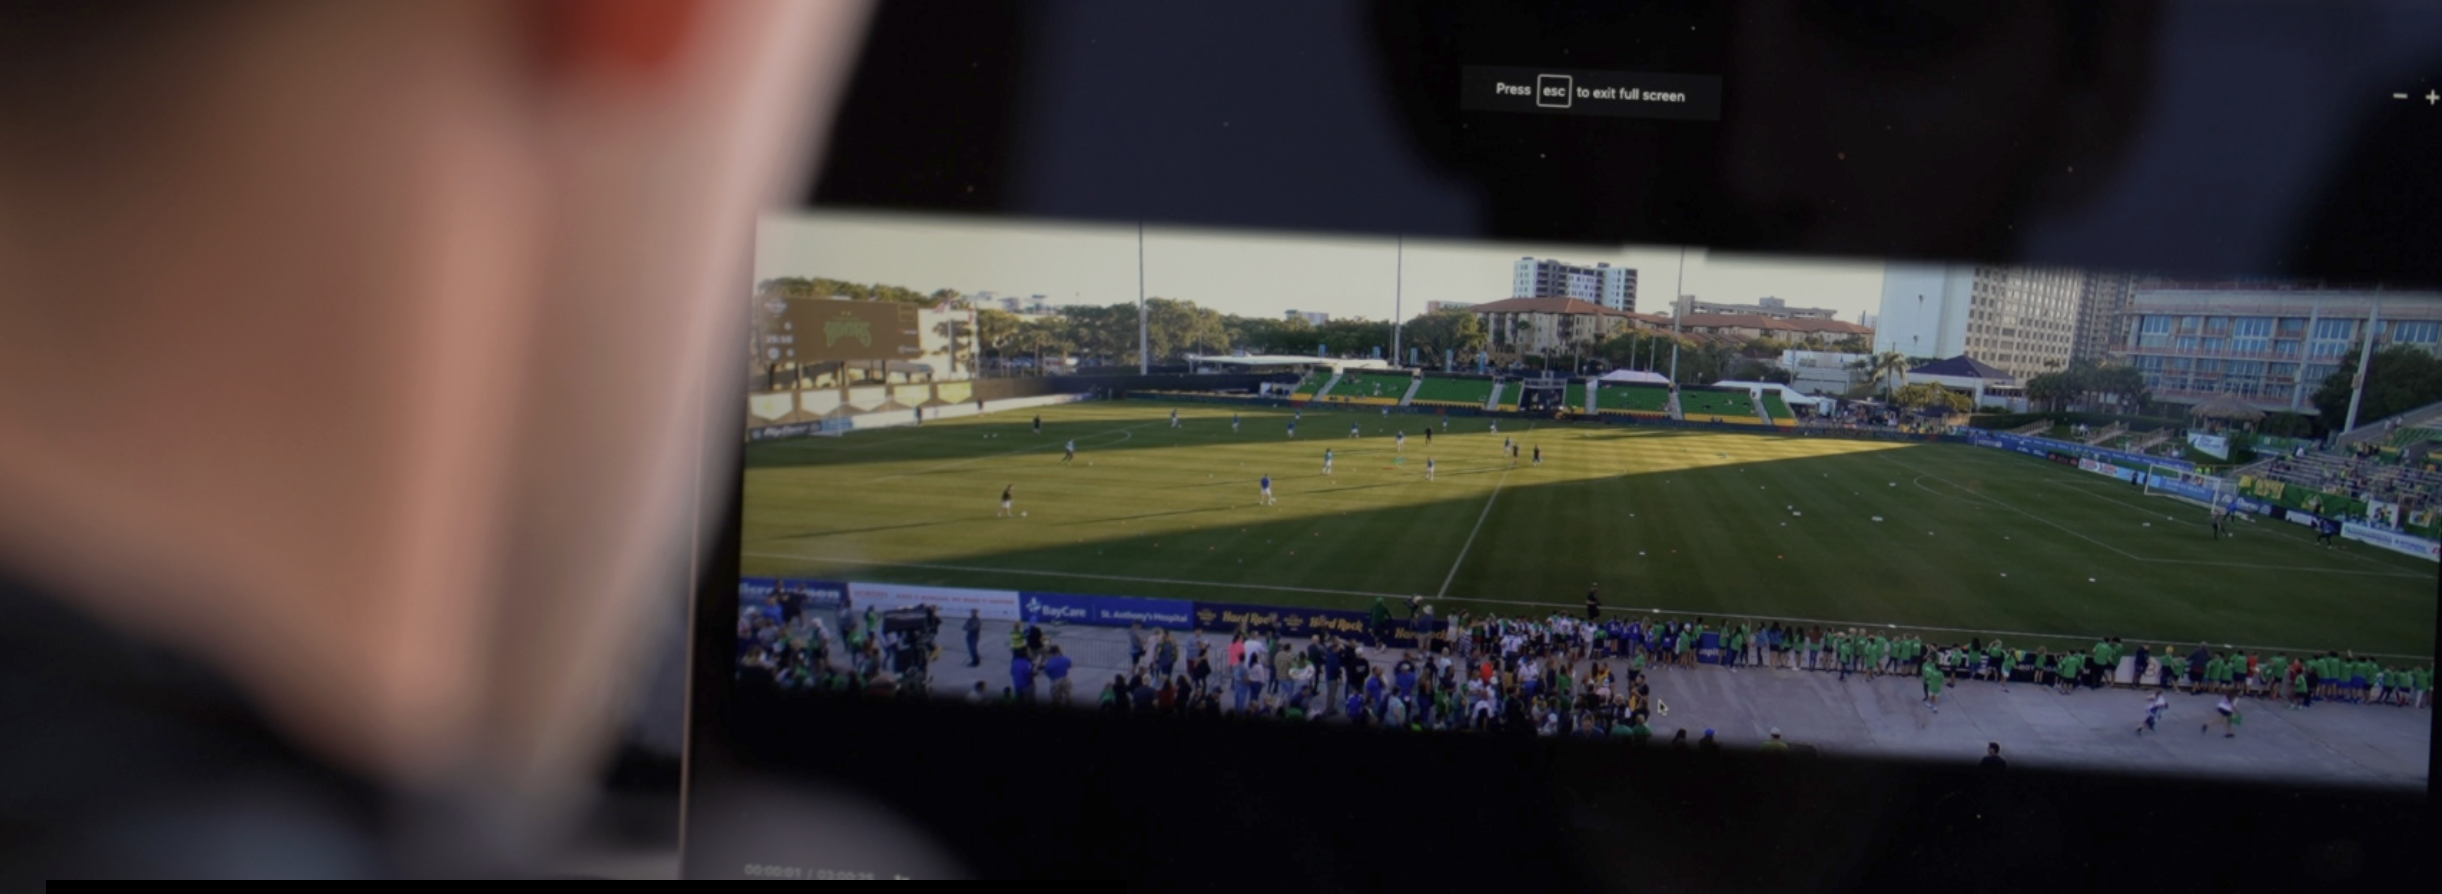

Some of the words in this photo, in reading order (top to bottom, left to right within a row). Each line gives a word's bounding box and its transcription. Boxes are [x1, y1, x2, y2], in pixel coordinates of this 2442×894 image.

[1496, 82, 1531, 96] Press
[1542, 87, 1566, 97] esc
[1576, 86, 1590, 98] to
[1592, 87, 1616, 99] exit
[1619, 87, 1639, 100] full
[1642, 91, 1685, 102] screen
[1042, 605, 1087, 619] BayCare
[1101, 610, 1110, 619] St.
[1113, 611, 1153, 622] Anthony's
[1154, 613, 1188, 623] Hospital
[1222, 611, 1250, 623] Hard
[1337, 618, 1364, 632] Rock
